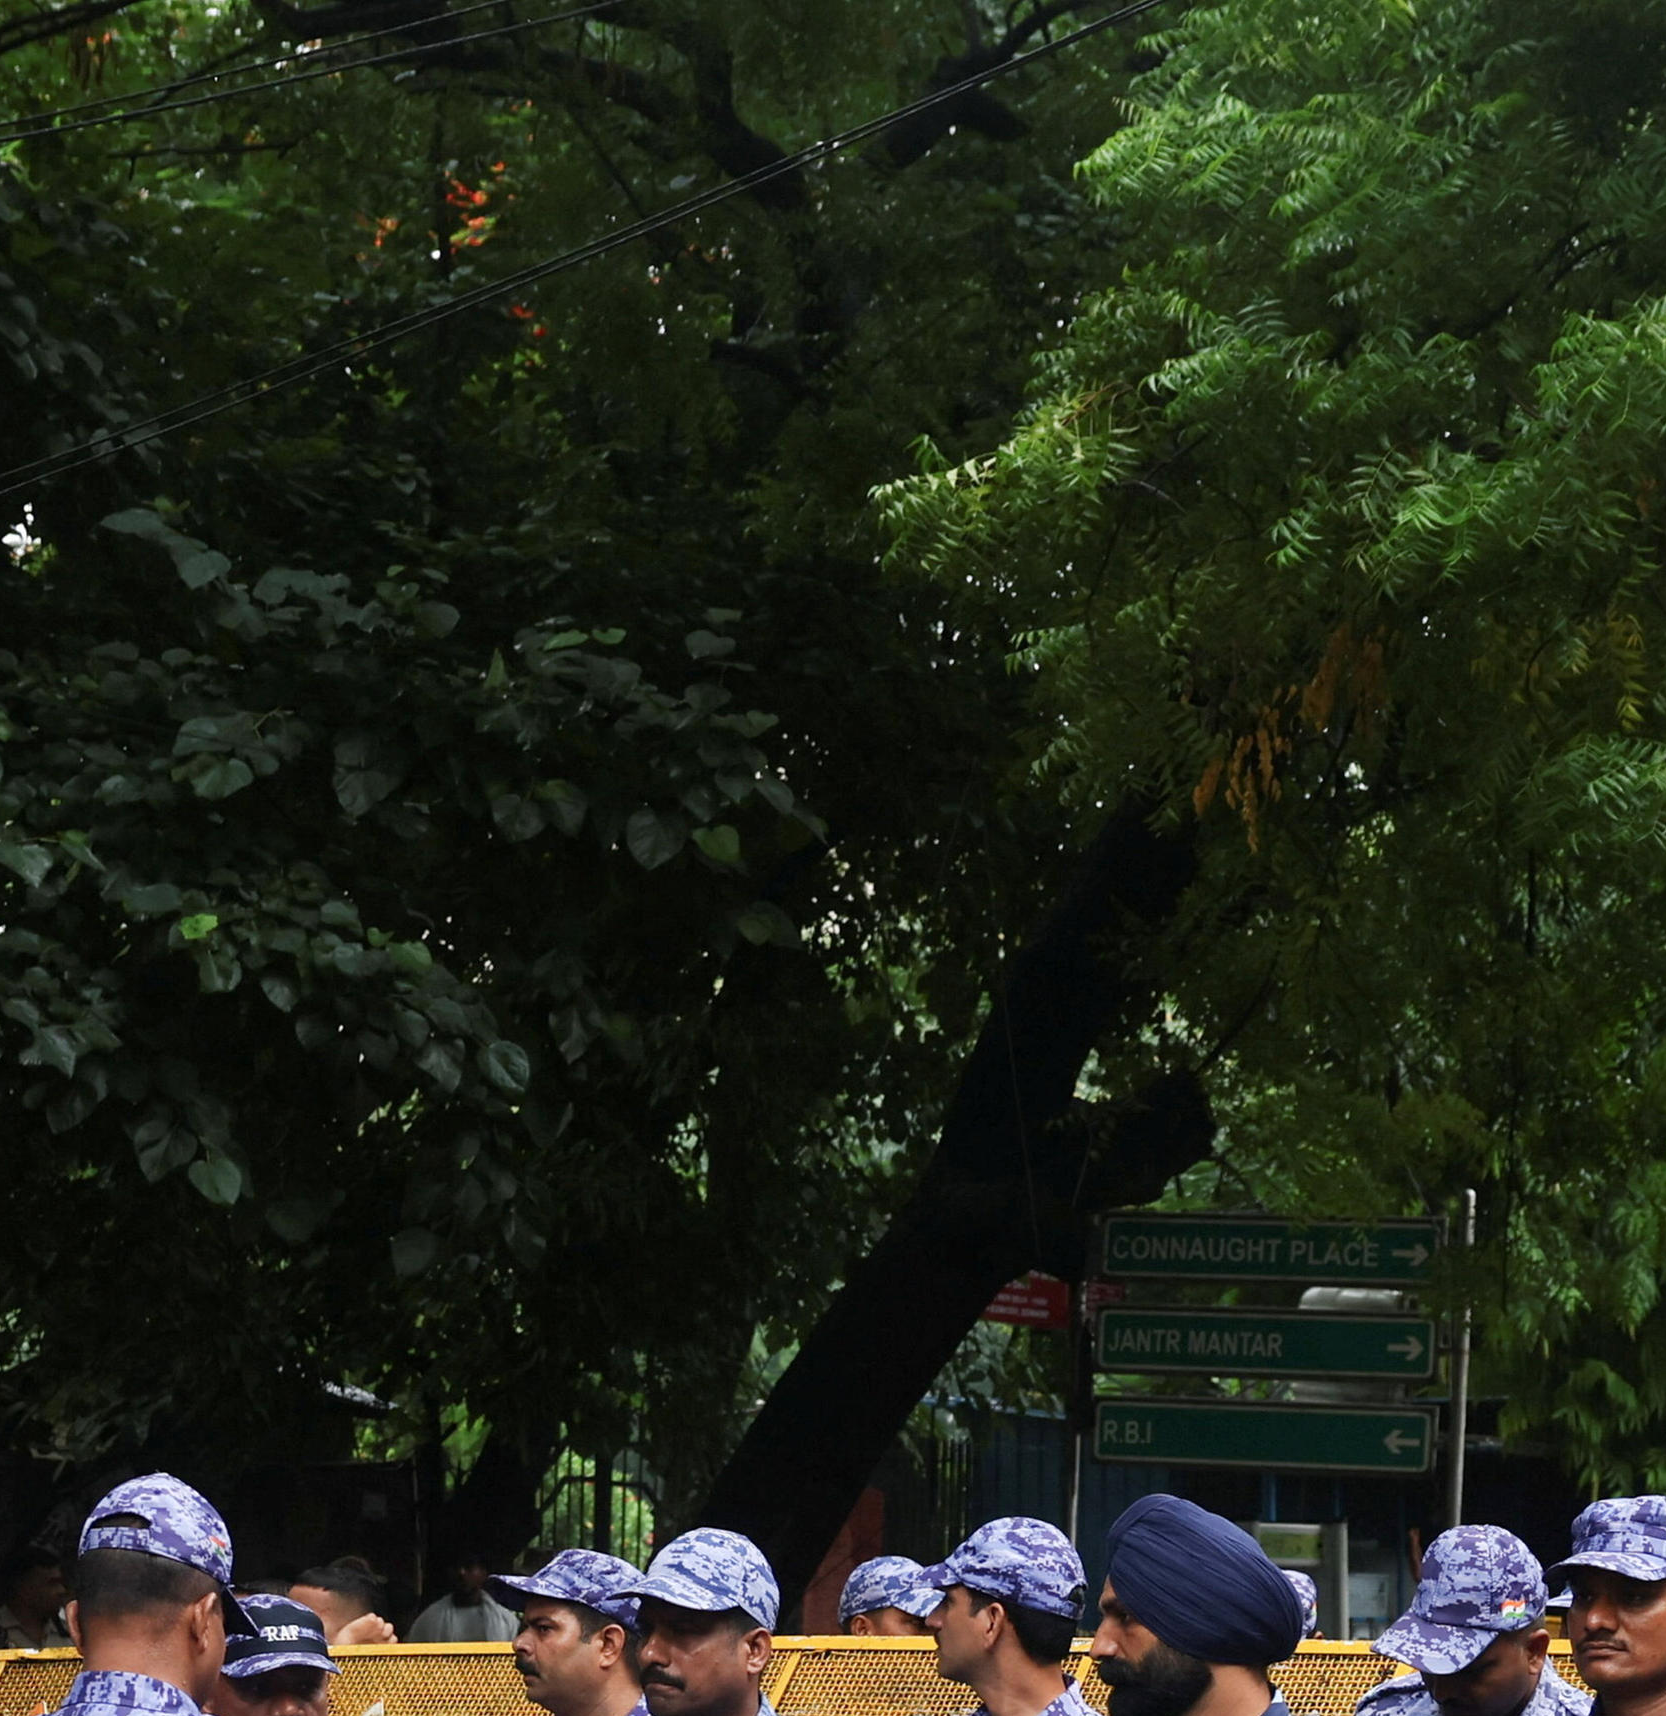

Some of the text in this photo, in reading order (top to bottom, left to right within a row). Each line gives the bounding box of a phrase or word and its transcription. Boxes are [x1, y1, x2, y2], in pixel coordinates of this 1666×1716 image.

[1112, 1234, 1380, 1268] CONNAUGHT PLACE
[1107, 1328, 1284, 1358] JANTR MANTAR
[265, 1624, 301, 1643] RAF
